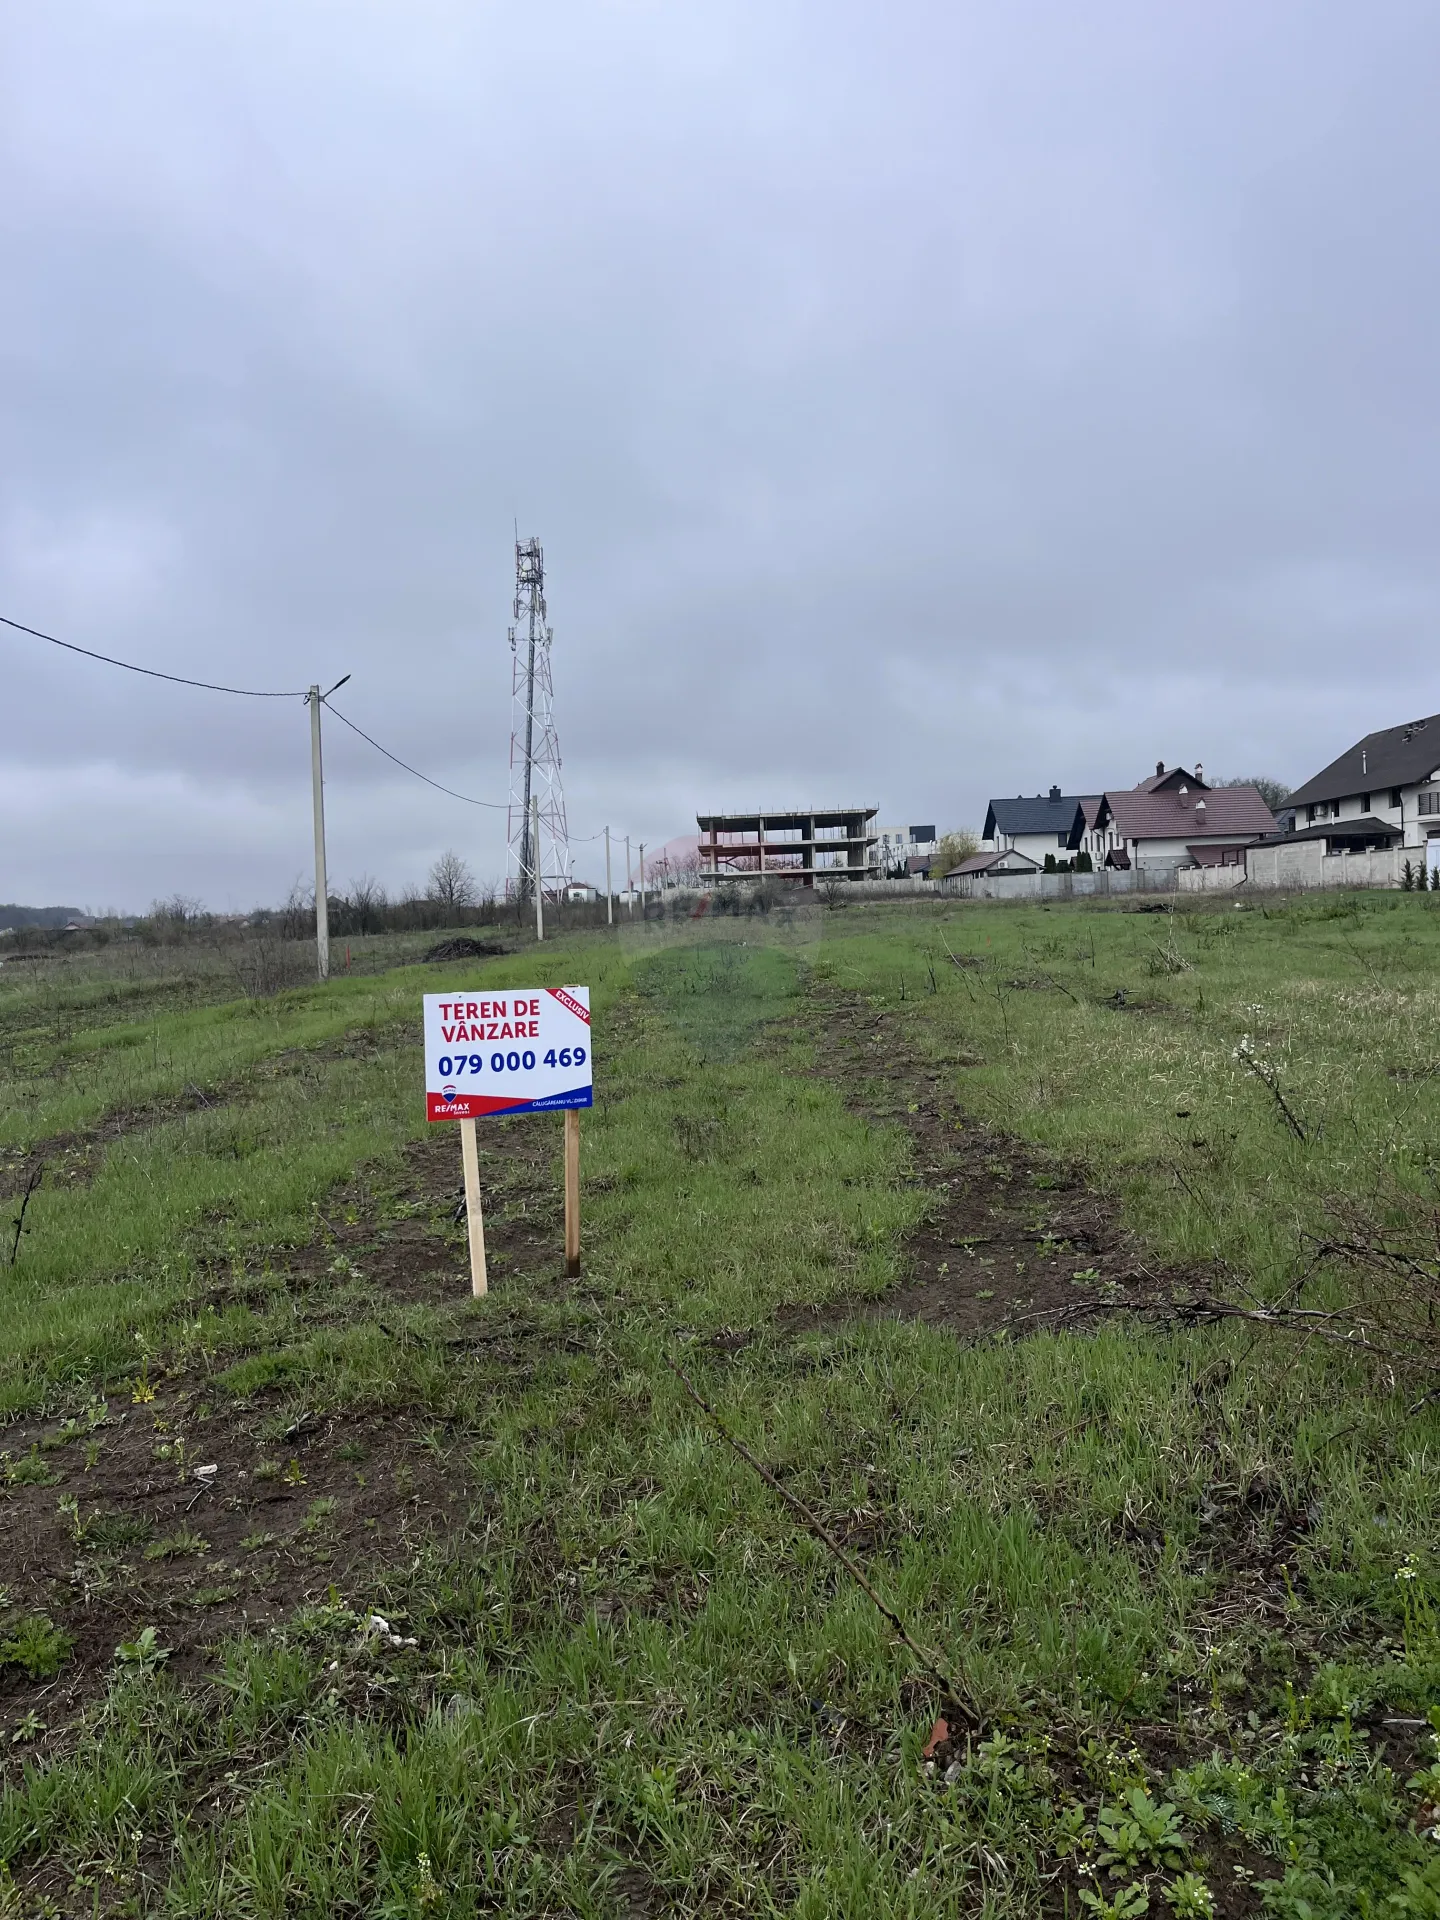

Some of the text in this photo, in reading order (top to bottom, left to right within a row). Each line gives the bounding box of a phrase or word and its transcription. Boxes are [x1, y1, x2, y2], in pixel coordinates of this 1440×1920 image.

[439, 999, 541, 1021] TEREN DE
[555, 990, 589, 1020] EXCLUSIV
[441, 1021, 540, 1043] VÂNZARE
[438, 1047, 586, 1077] 079 000 469
[434, 1103, 470, 1113] RE/MAX
